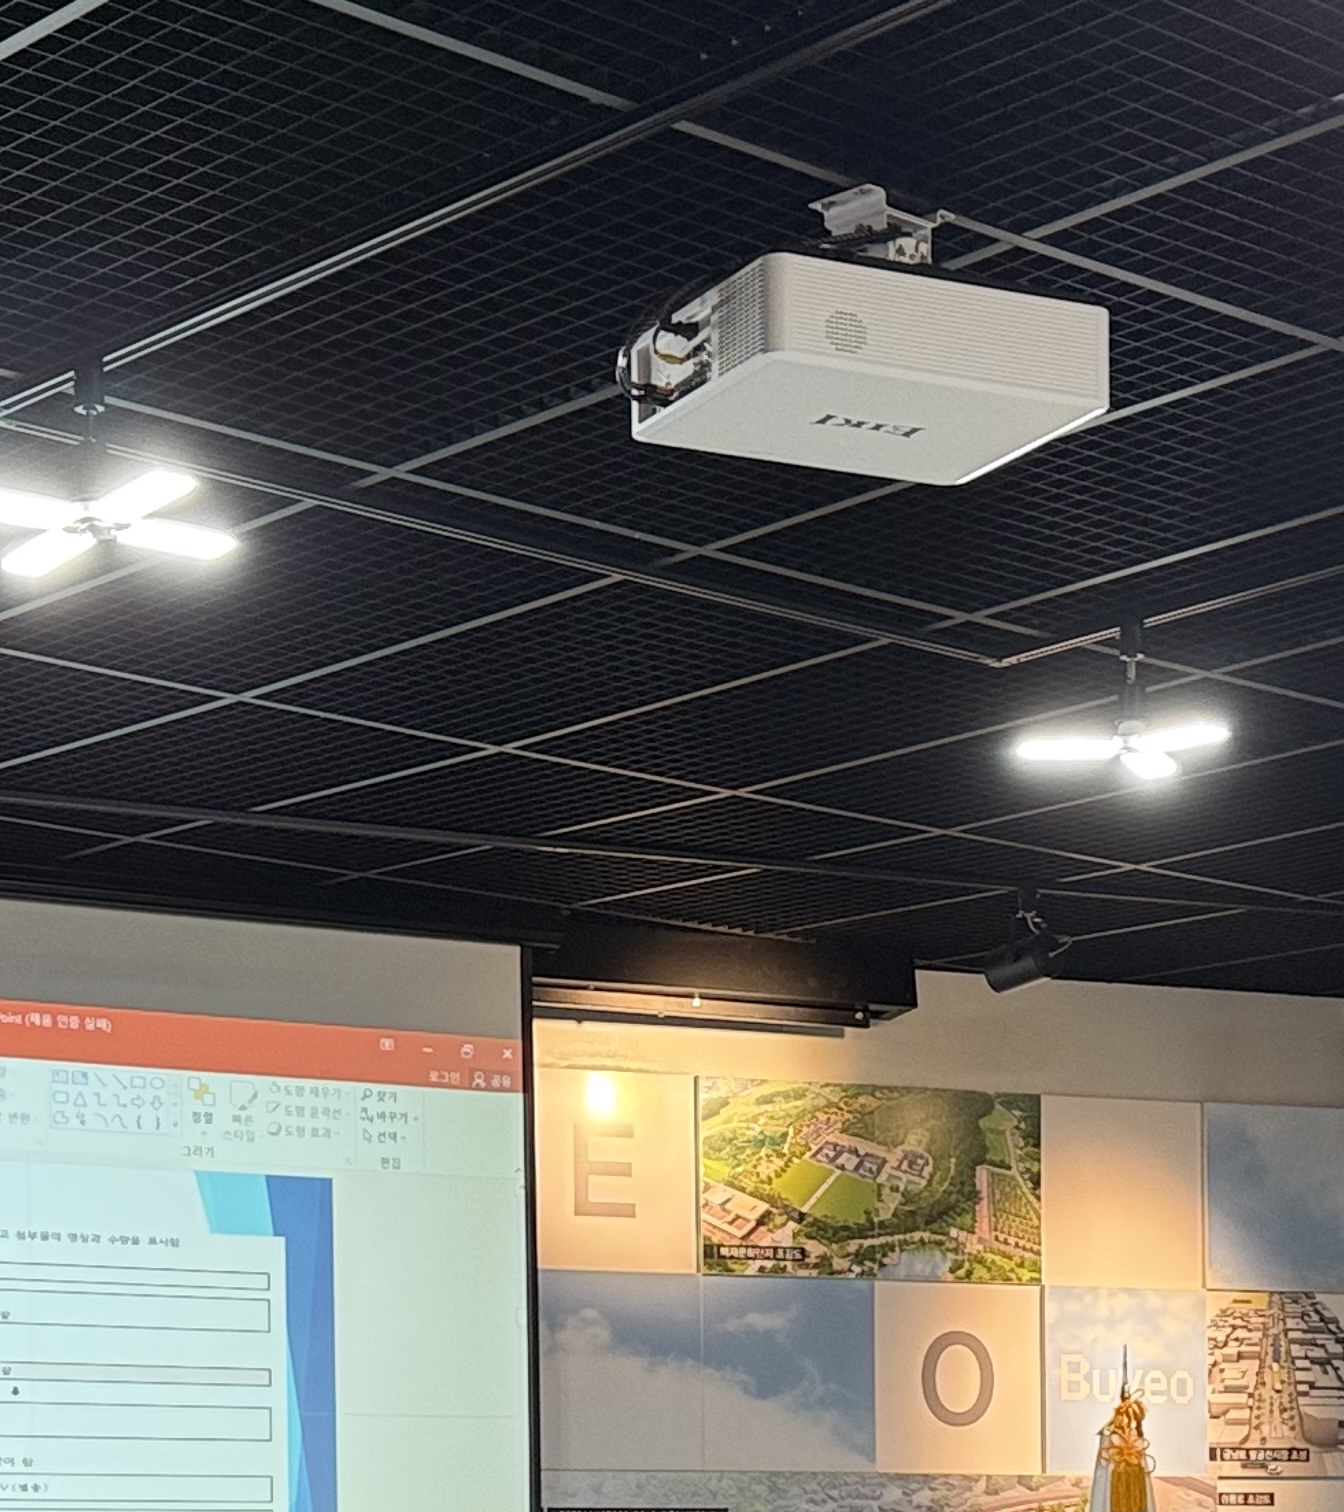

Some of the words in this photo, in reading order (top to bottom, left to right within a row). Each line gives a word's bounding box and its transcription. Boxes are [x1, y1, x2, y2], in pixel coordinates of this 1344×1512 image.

[809, 413, 927, 440] EIKI
[25, 1012, 52, 1028] (제품
[56, 1014, 81, 1029] 인증
[429, 1070, 461, 1085] 로그인
[490, 1074, 512, 1088] 공유
[283, 1084, 306, 1098] 도형
[309, 1084, 342, 1099] 채우기
[376, 1090, 398, 1104] 찾기
[192, 1111, 214, 1125] 정렬
[284, 1105, 306, 1119] 도형
[309, 1106, 342, 1121] 윤곽선
[376, 1110, 408, 1126] 바꾸기
[231, 1114, 254, 1128] 빠른
[222, 1129, 256, 1143] 스타일
[284, 1126, 306, 1139] 도형
[310, 1126, 332, 1140] 효과
[377, 1131, 398, 1144] 선택
[181, 1145, 215, 1159] 그리기
[381, 1157, 401, 1170] 편집
[573, 1121, 636, 1218] E
[921, 1330, 995, 1428] O
